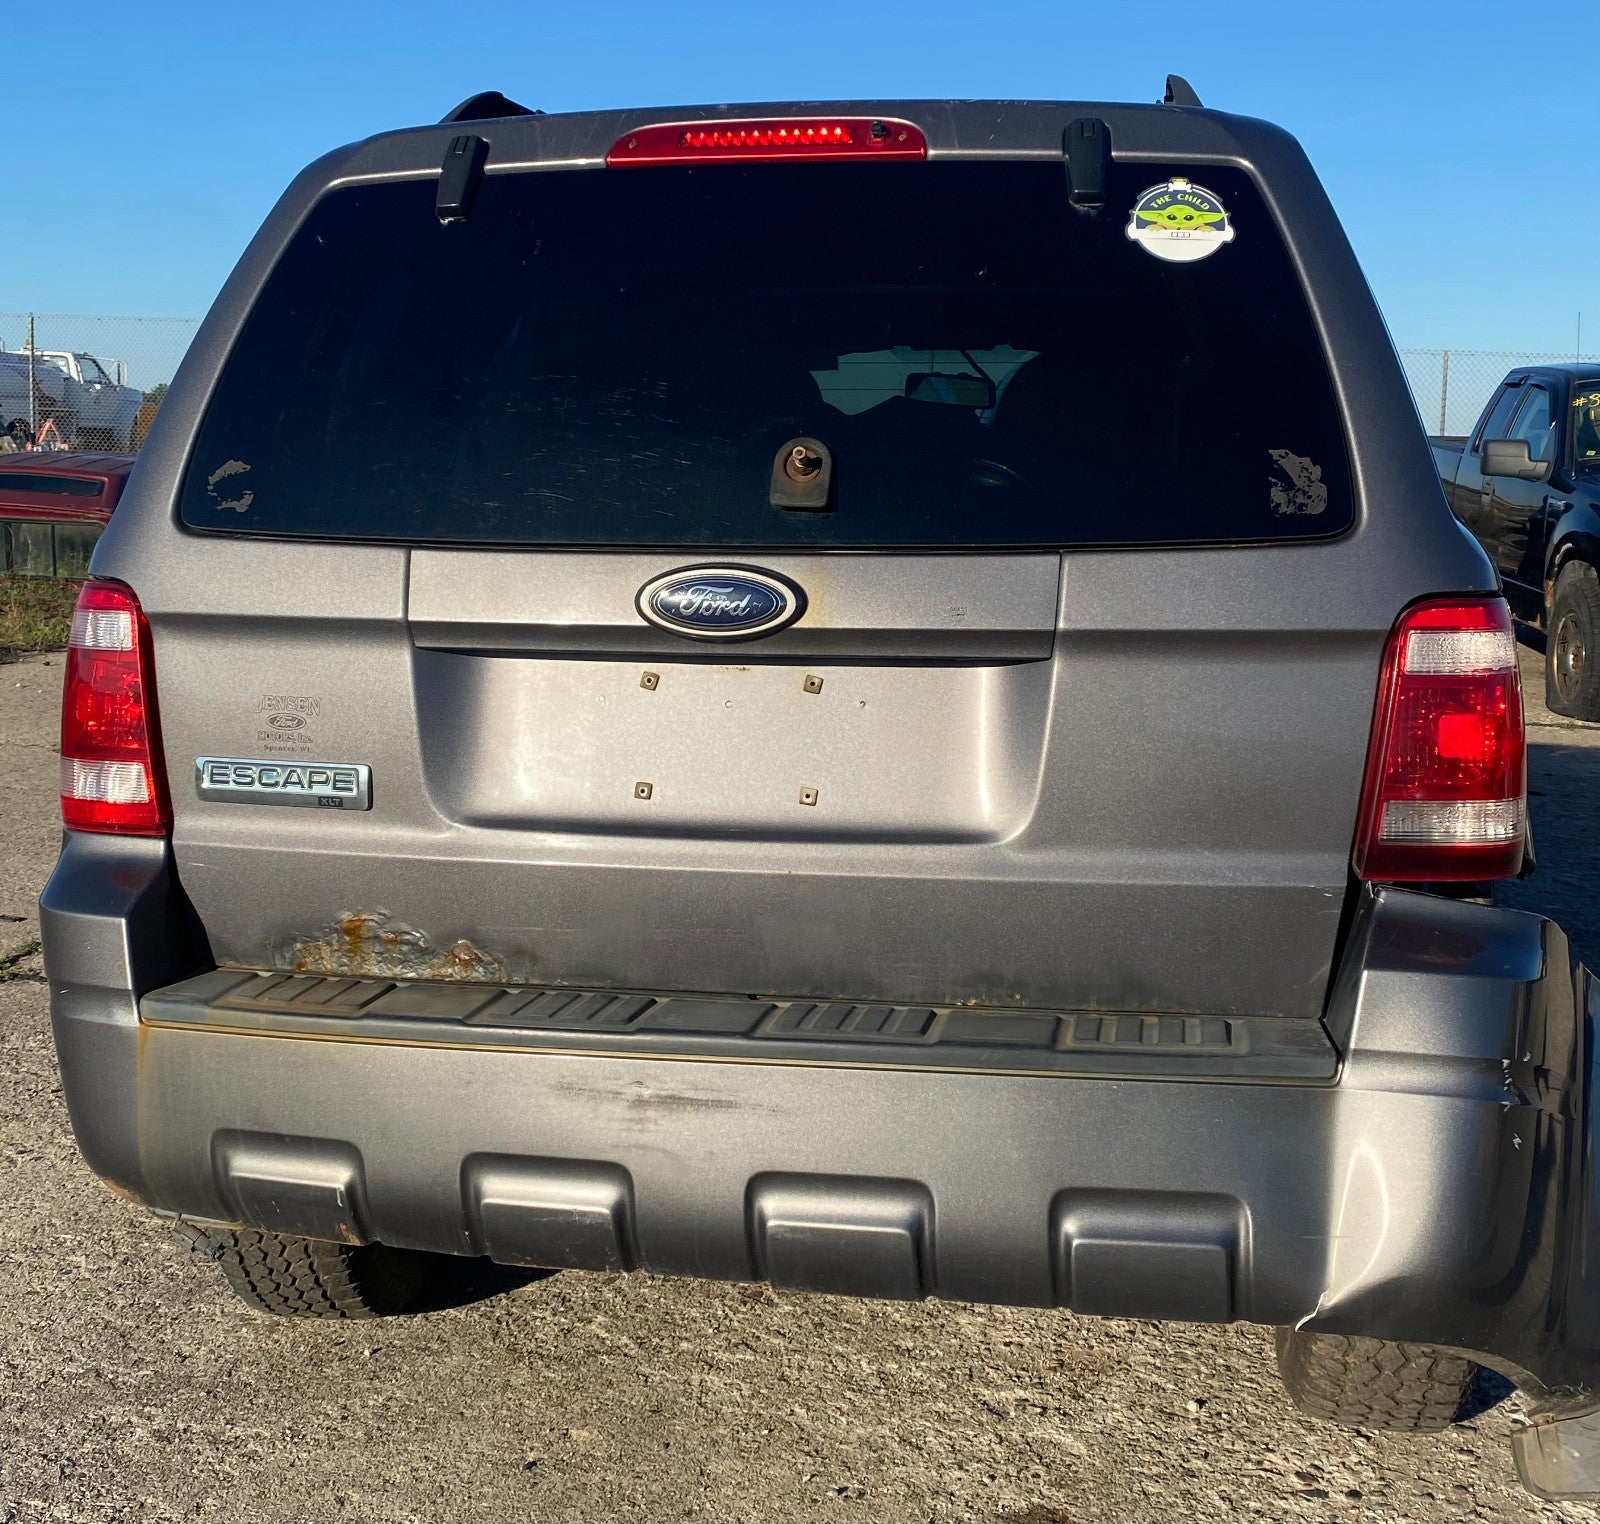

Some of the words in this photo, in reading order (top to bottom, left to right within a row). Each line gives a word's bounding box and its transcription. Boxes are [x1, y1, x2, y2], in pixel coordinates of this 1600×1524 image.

[1149, 194, 1172, 208] THE
[1177, 193, 1210, 210] CHILD
[679, 585, 751, 616] Ford
[252, 694, 321, 717] JENSEN
[263, 744, 297, 752] Spencer,
[299, 745, 310, 753] WI
[208, 763, 358, 794] ESCAPE
[319, 797, 341, 807] XLT
